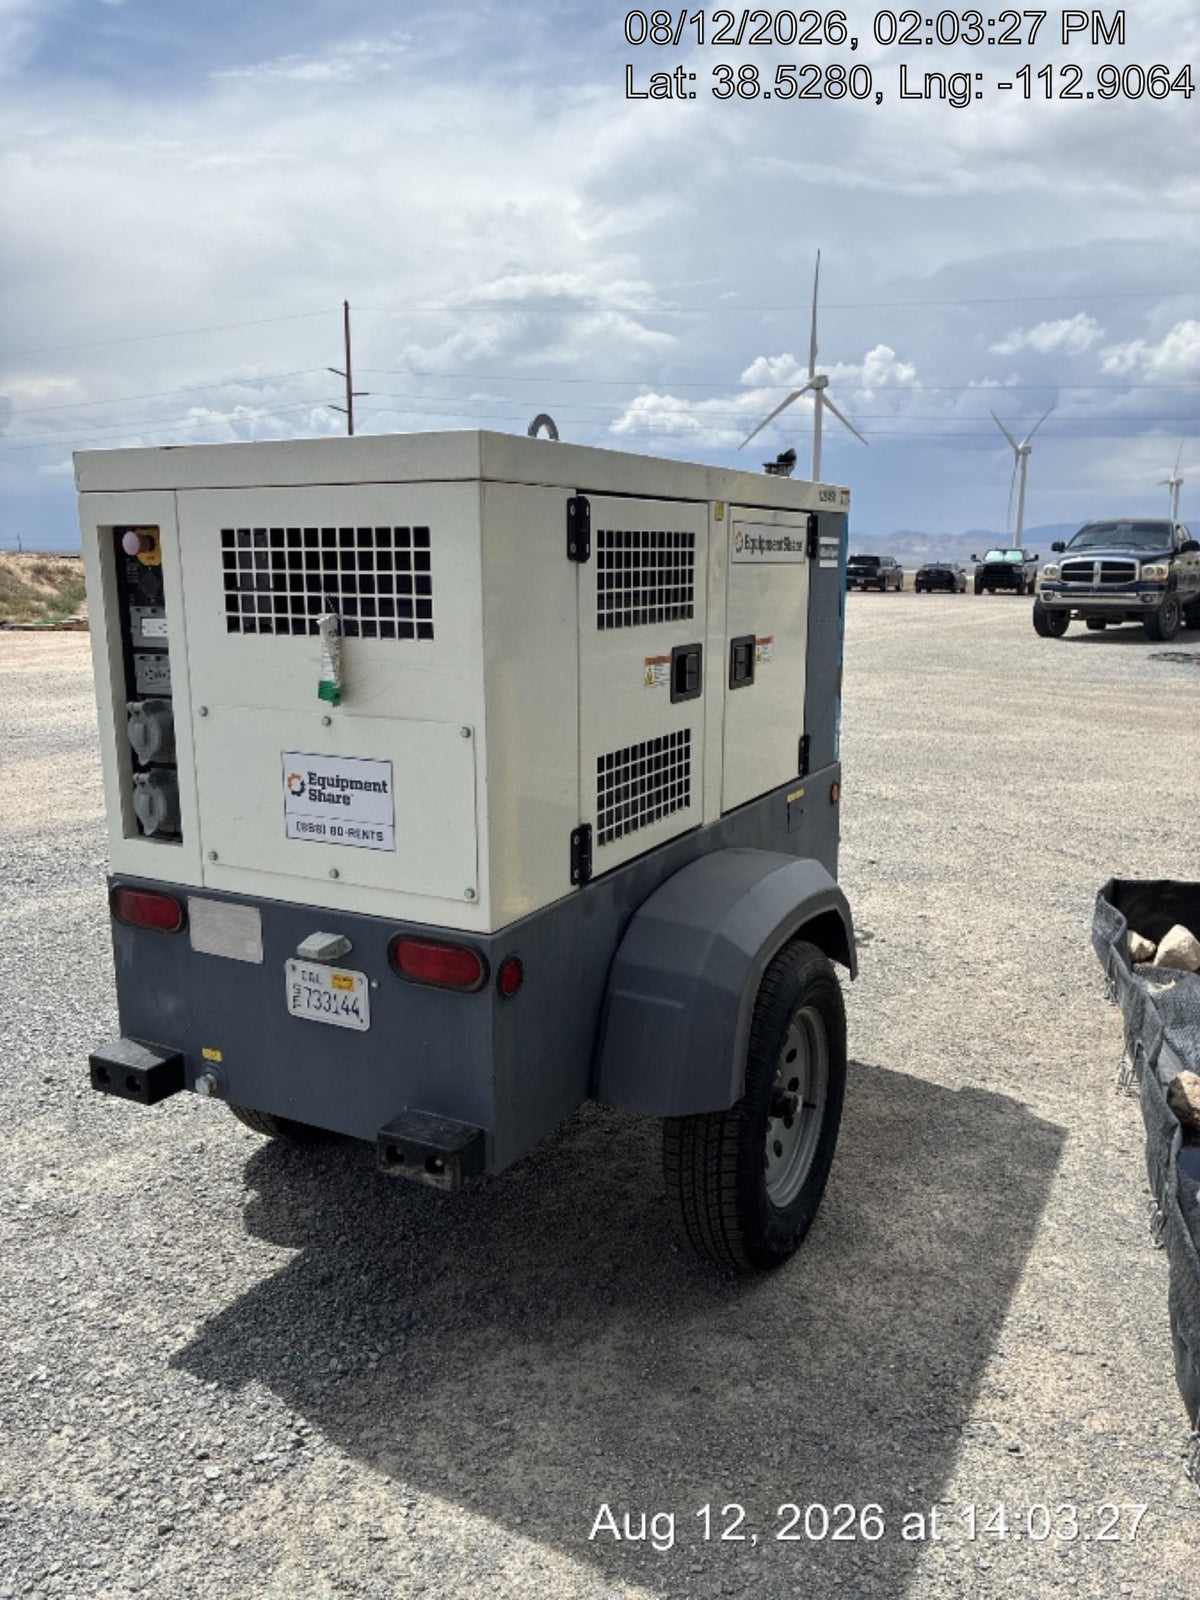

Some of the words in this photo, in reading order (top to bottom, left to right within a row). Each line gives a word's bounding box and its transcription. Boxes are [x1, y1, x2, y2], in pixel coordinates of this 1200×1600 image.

[307, 771, 389, 794] Equipment
[308, 788, 352, 806] Share
[303, 987, 360, 1018] 733144
